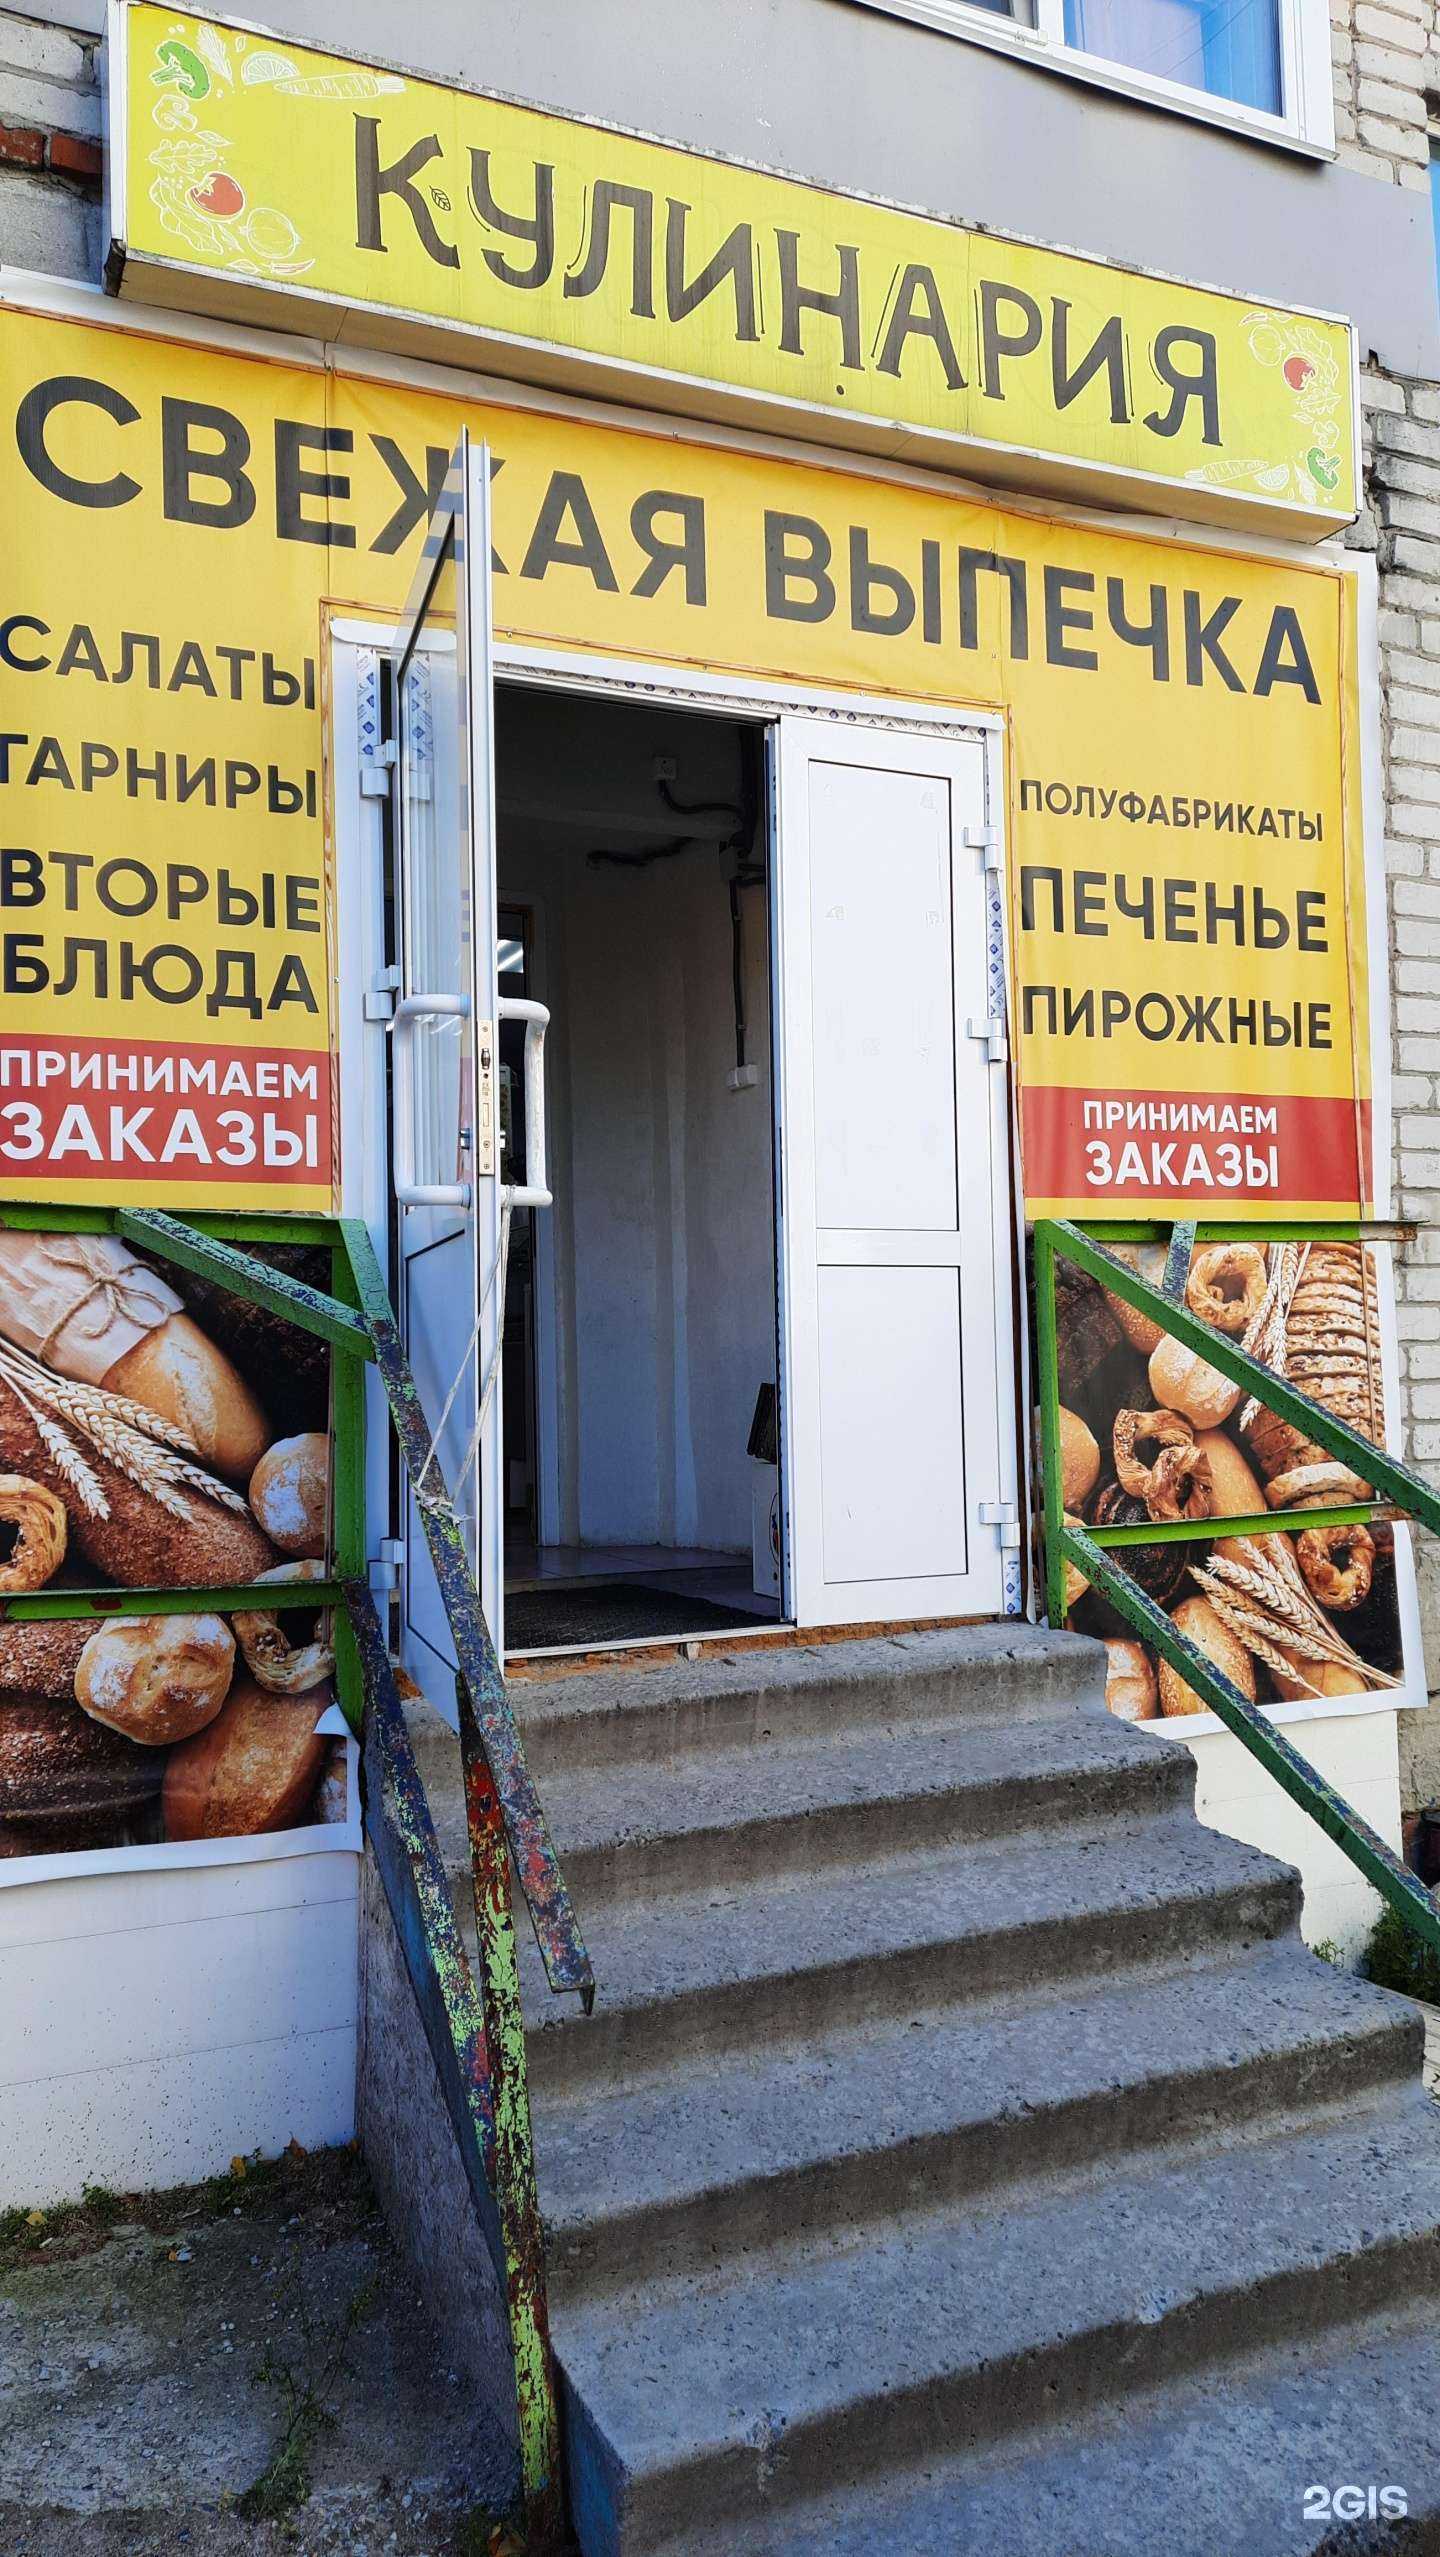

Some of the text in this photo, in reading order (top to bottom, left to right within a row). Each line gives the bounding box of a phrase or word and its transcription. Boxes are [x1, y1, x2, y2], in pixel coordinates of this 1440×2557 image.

[352, 112, 1223, 447] КУЛИНАРИЯ
[15, 376, 1323, 705] СВЕЖАЯ ВЫПЕЧКА
[0, 615, 316, 710] САЛАТЫ
[0, 733, 317, 818] ГАРНИРЫ
[1020, 779, 1324, 842] ПОЛУФАБРИКАТЫ
[0, 848, 321, 932] ВТОРЫЕ
[1020, 865, 1329, 953] ПЕЧЕНЬЕ
[3, 933, 319, 1020] БЛЮДА
[1022, 985, 1333, 1049] ПИРОЖНЫЕ
[0, 1048, 319, 1100] ПРИНИМАЕМ
[0, 1101, 319, 1167] ЗАКАЗЫ
[1083, 1100, 1278, 1135] ПРИНИМАЕМ
[1084, 1141, 1279, 1188] ЗАКАЗЫ
